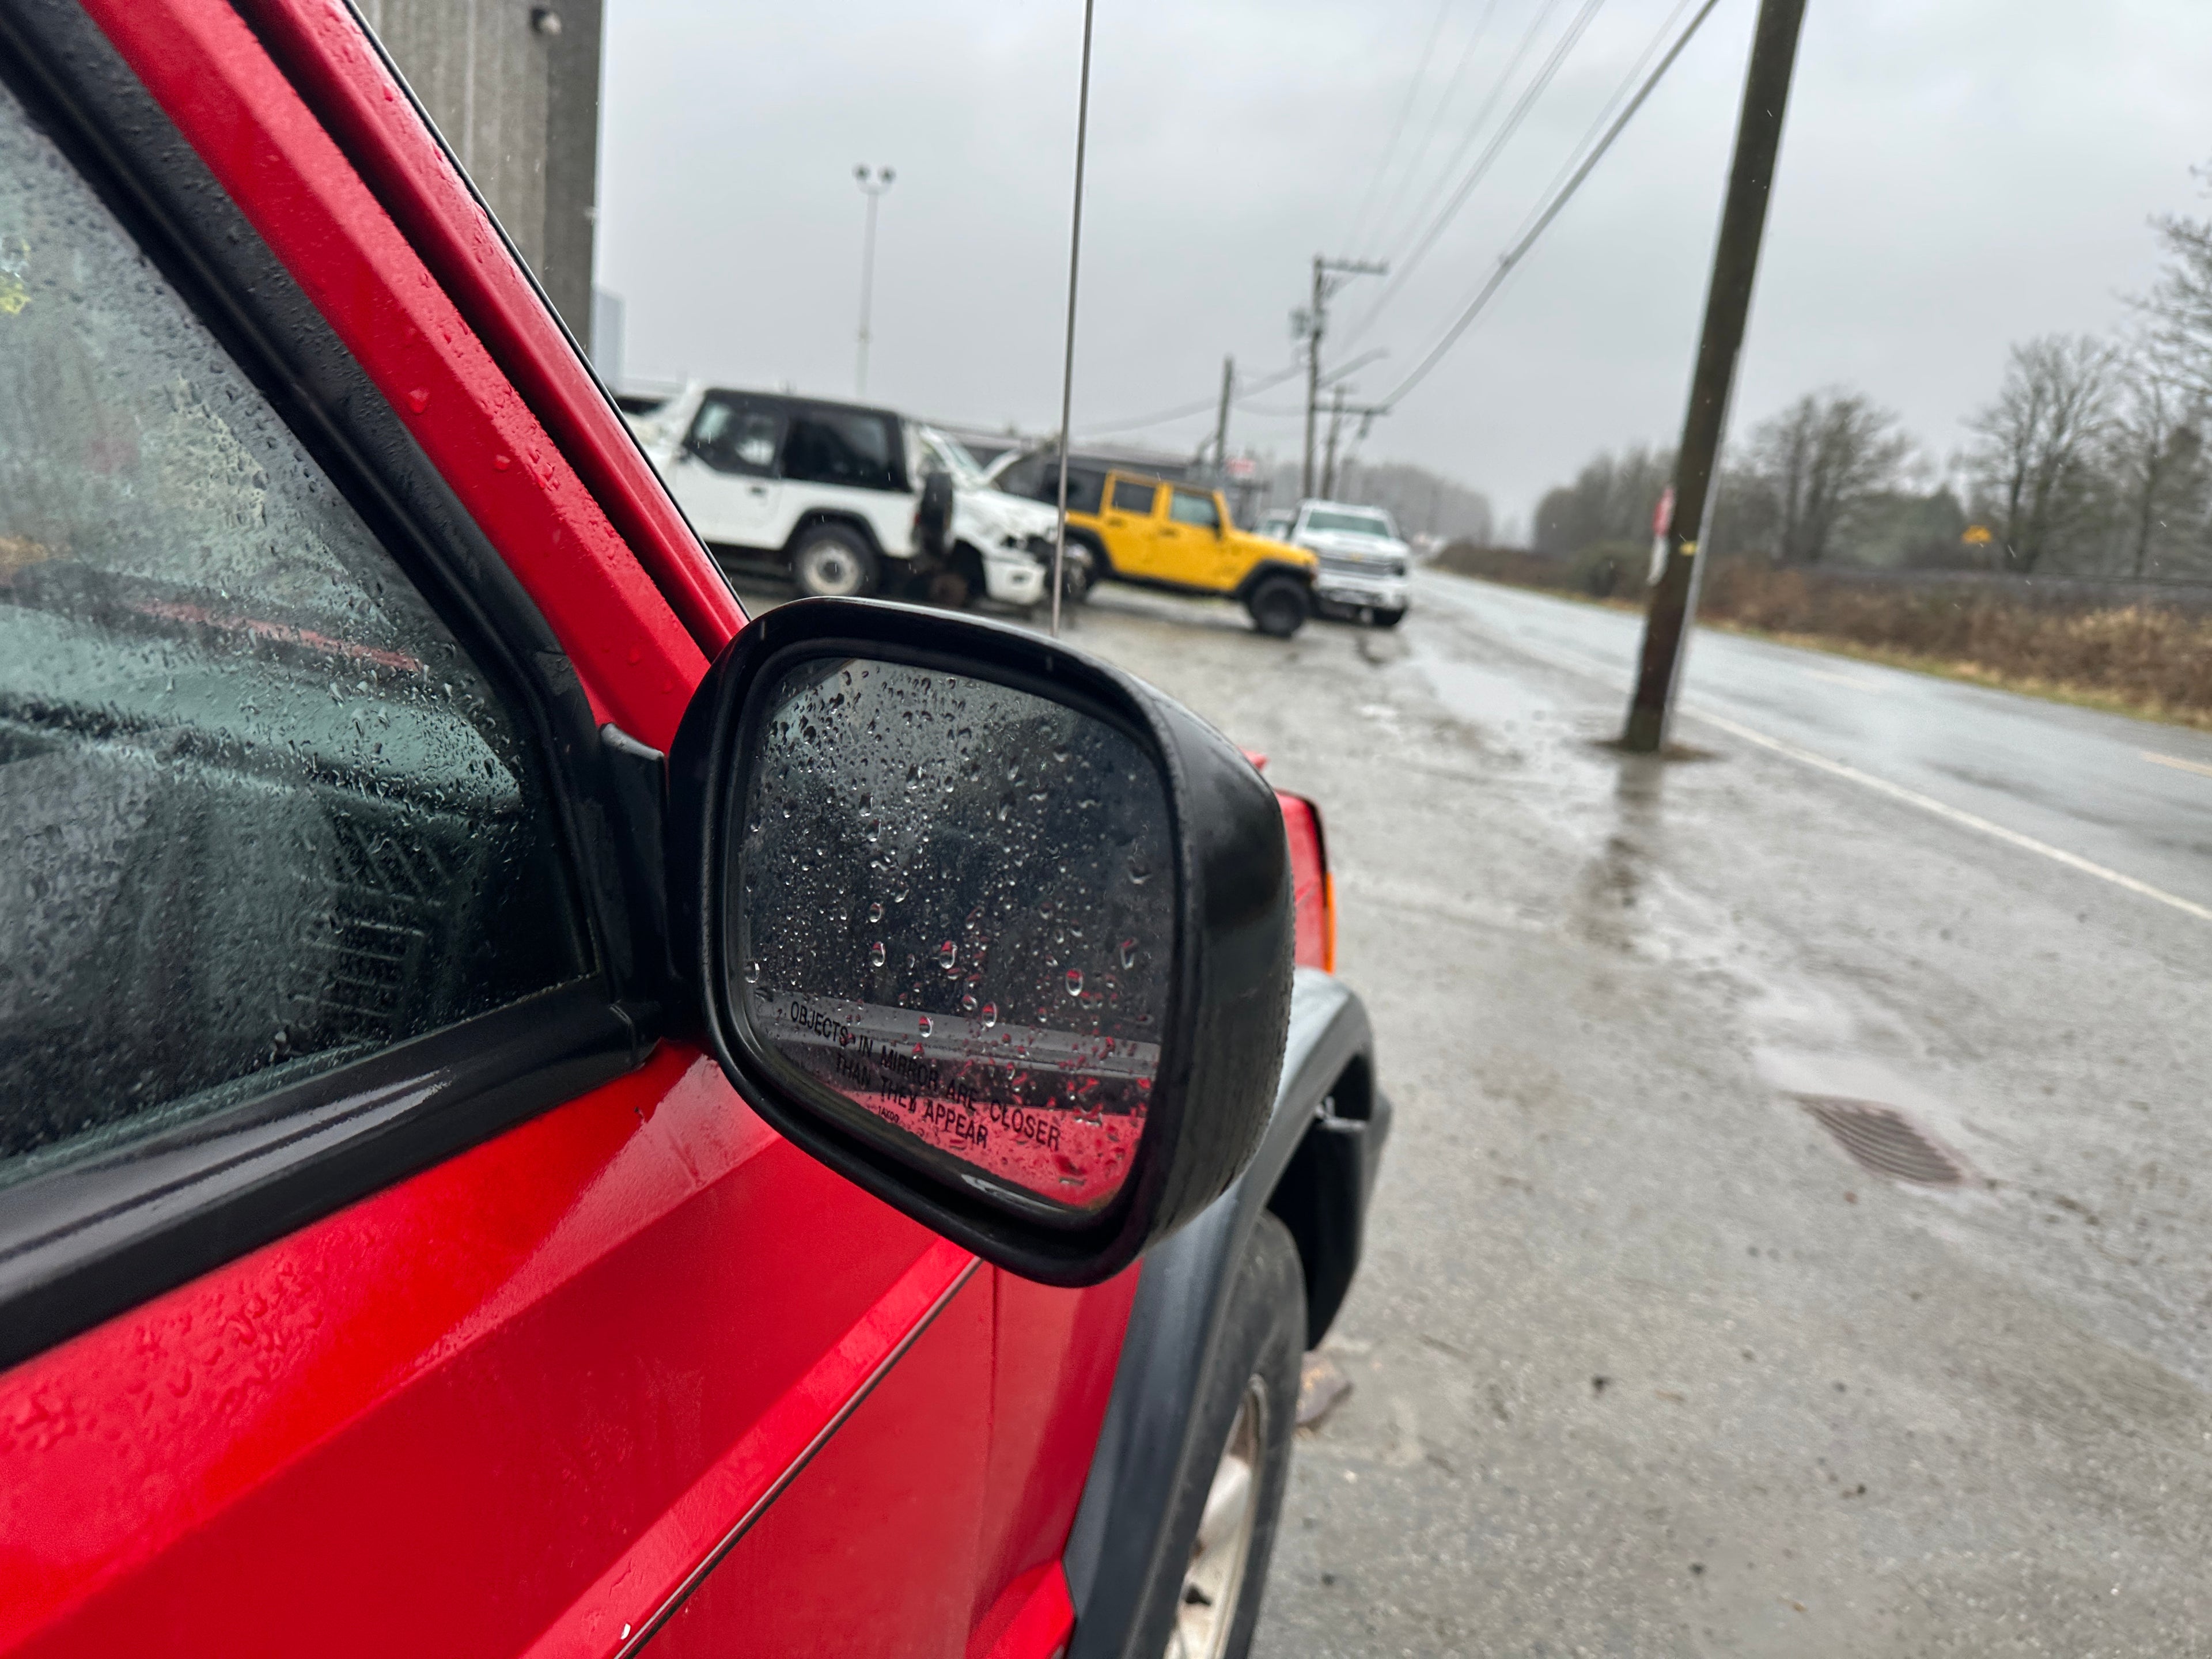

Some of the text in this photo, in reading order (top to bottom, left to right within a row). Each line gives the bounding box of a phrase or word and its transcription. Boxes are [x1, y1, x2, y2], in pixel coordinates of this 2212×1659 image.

[791, 1001, 1060, 1151] OBJECTS IN MIRROR ARE CLOSER
[836, 1053, 988, 1149] THAN THEY APPEAR
